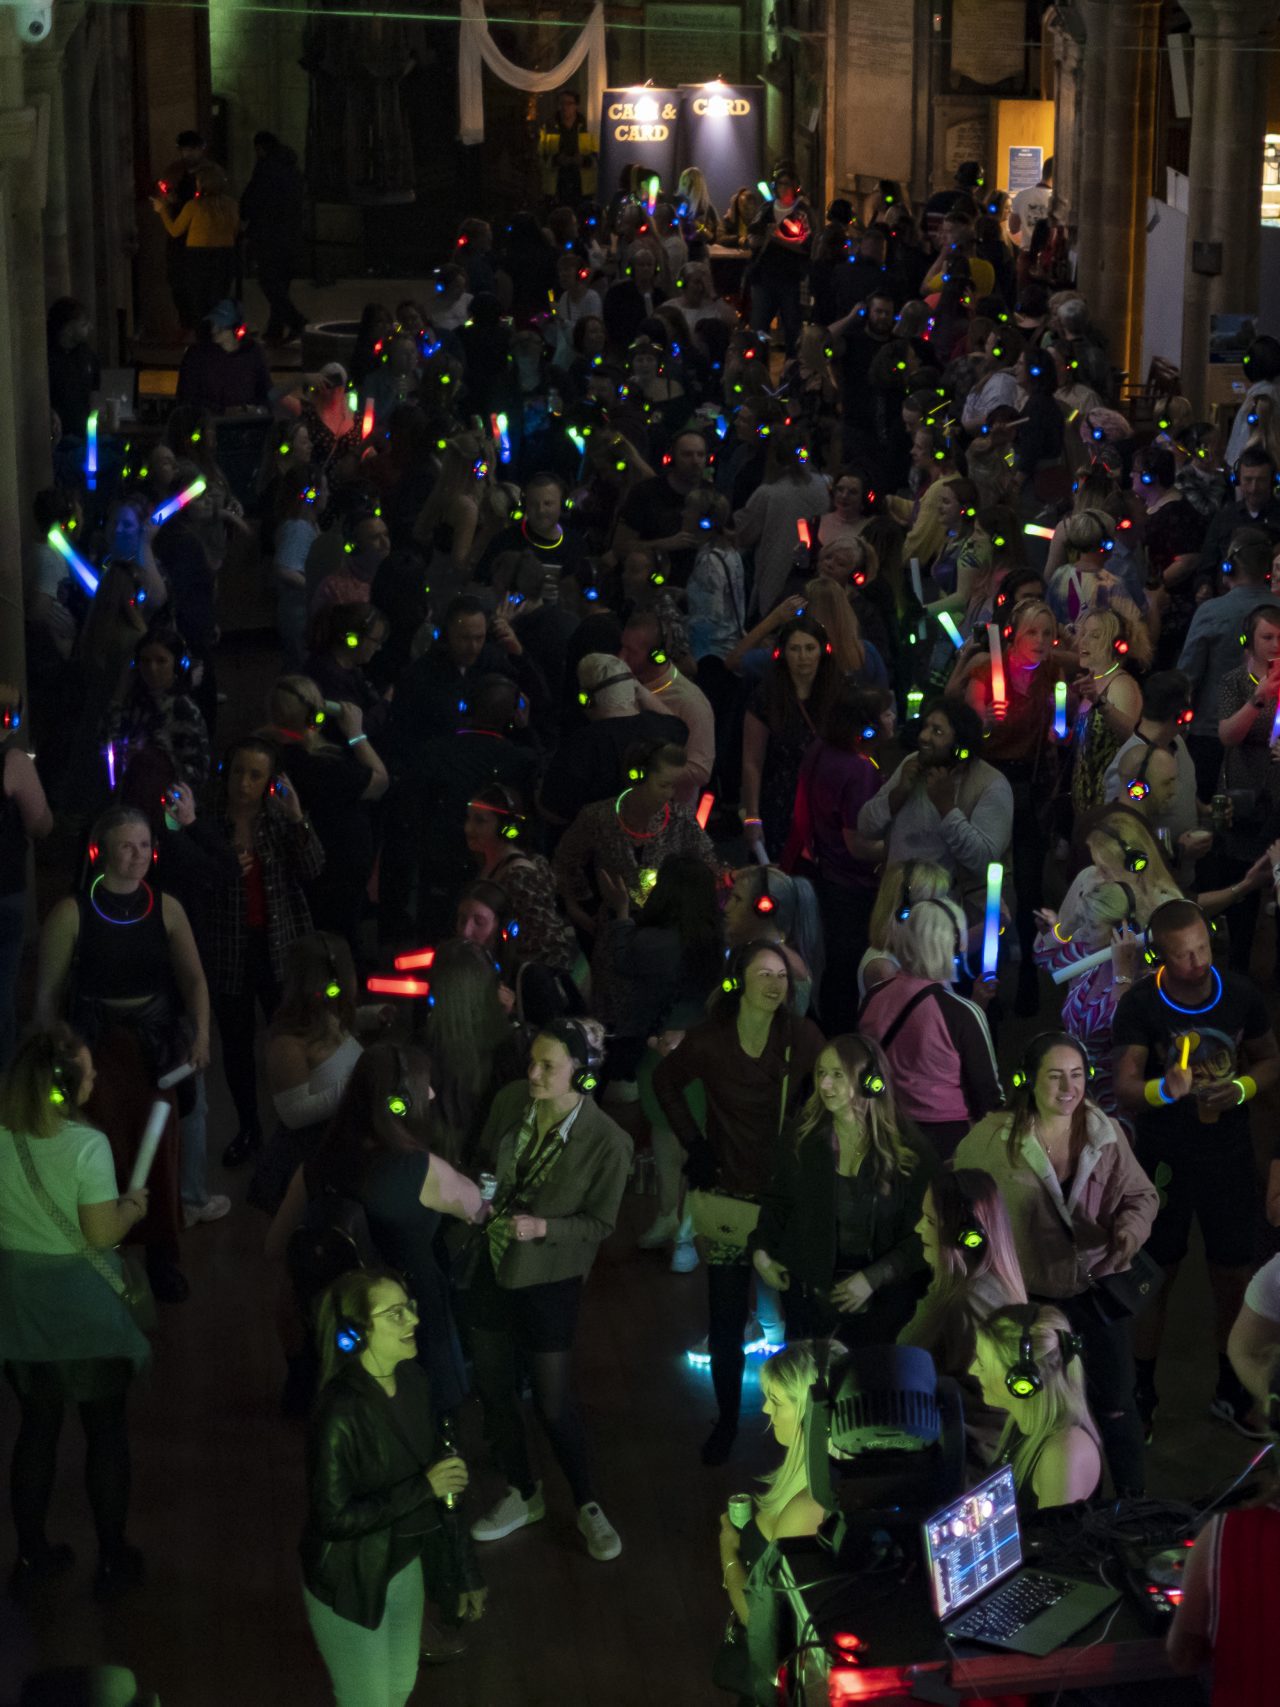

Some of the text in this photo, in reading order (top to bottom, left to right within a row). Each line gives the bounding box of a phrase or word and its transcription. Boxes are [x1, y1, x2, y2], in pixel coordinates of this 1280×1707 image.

[608, 103, 677, 120] CA &
[692, 98, 750, 116] CRD
[614, 124, 669, 141] CARD
